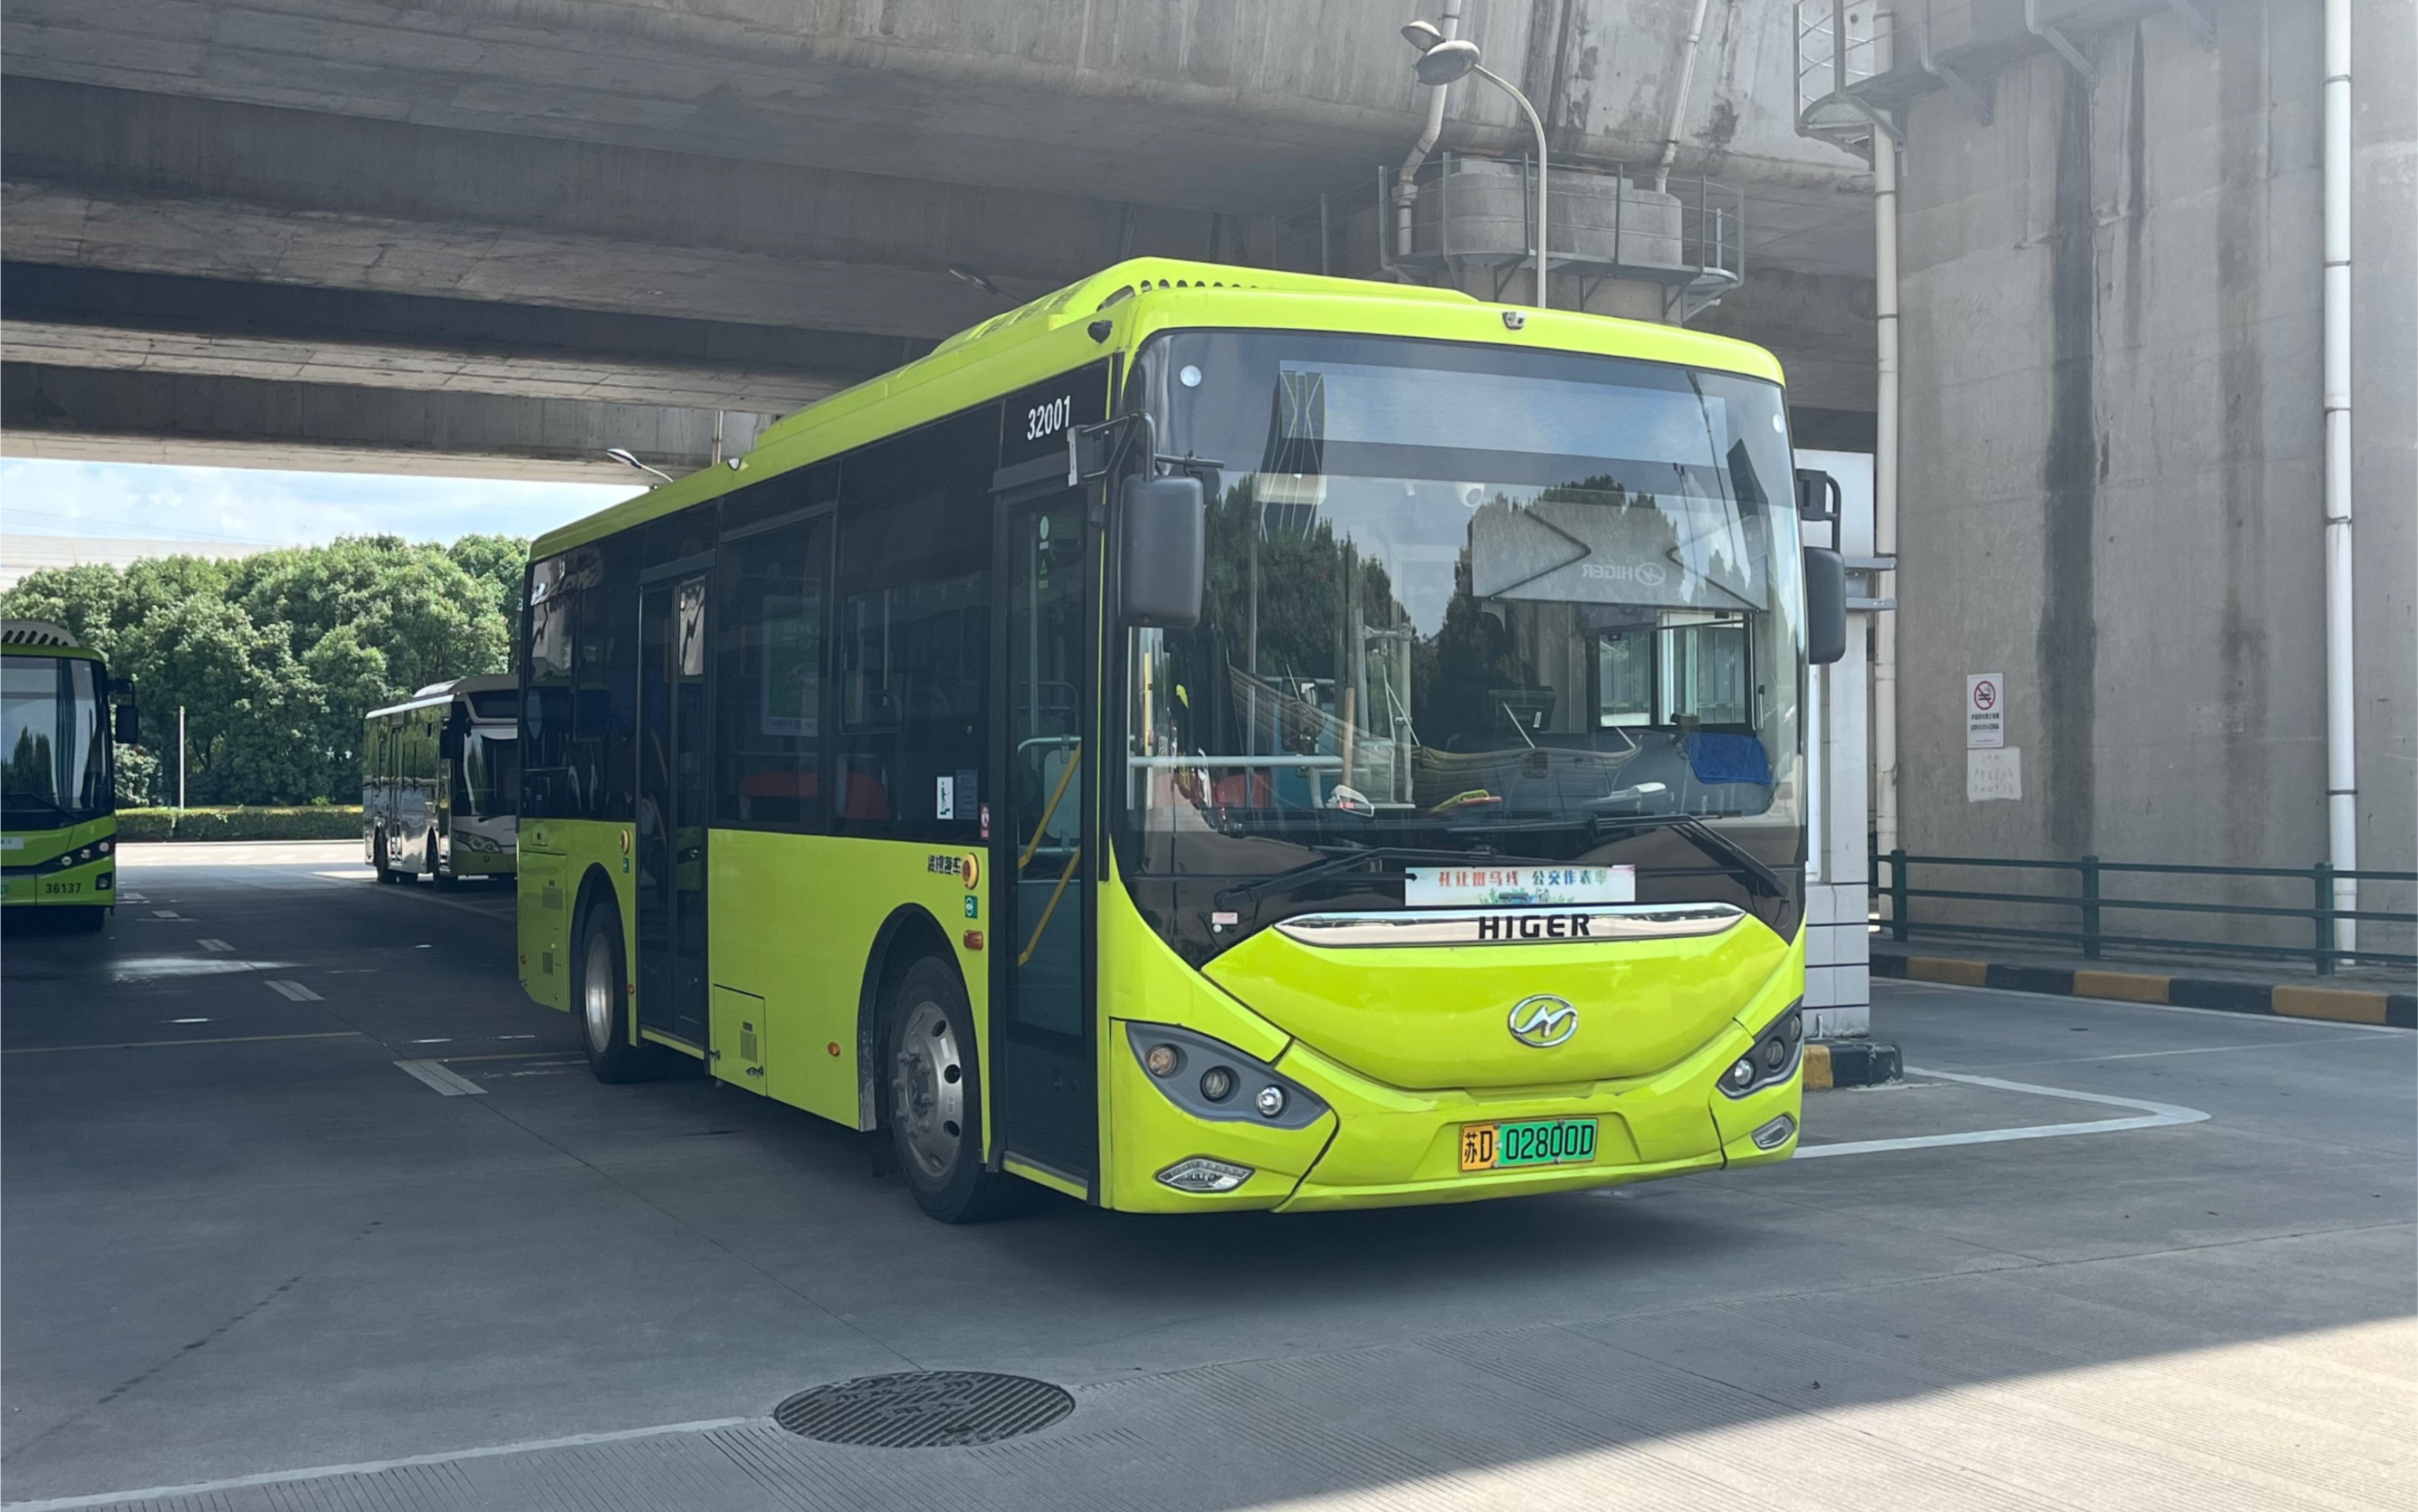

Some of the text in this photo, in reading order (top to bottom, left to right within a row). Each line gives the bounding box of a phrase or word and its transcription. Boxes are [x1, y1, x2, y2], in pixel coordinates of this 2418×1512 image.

[1027, 394, 1071, 440] 32001
[46, 883, 82, 893] 36137
[1478, 913, 1590, 940] HIGER
